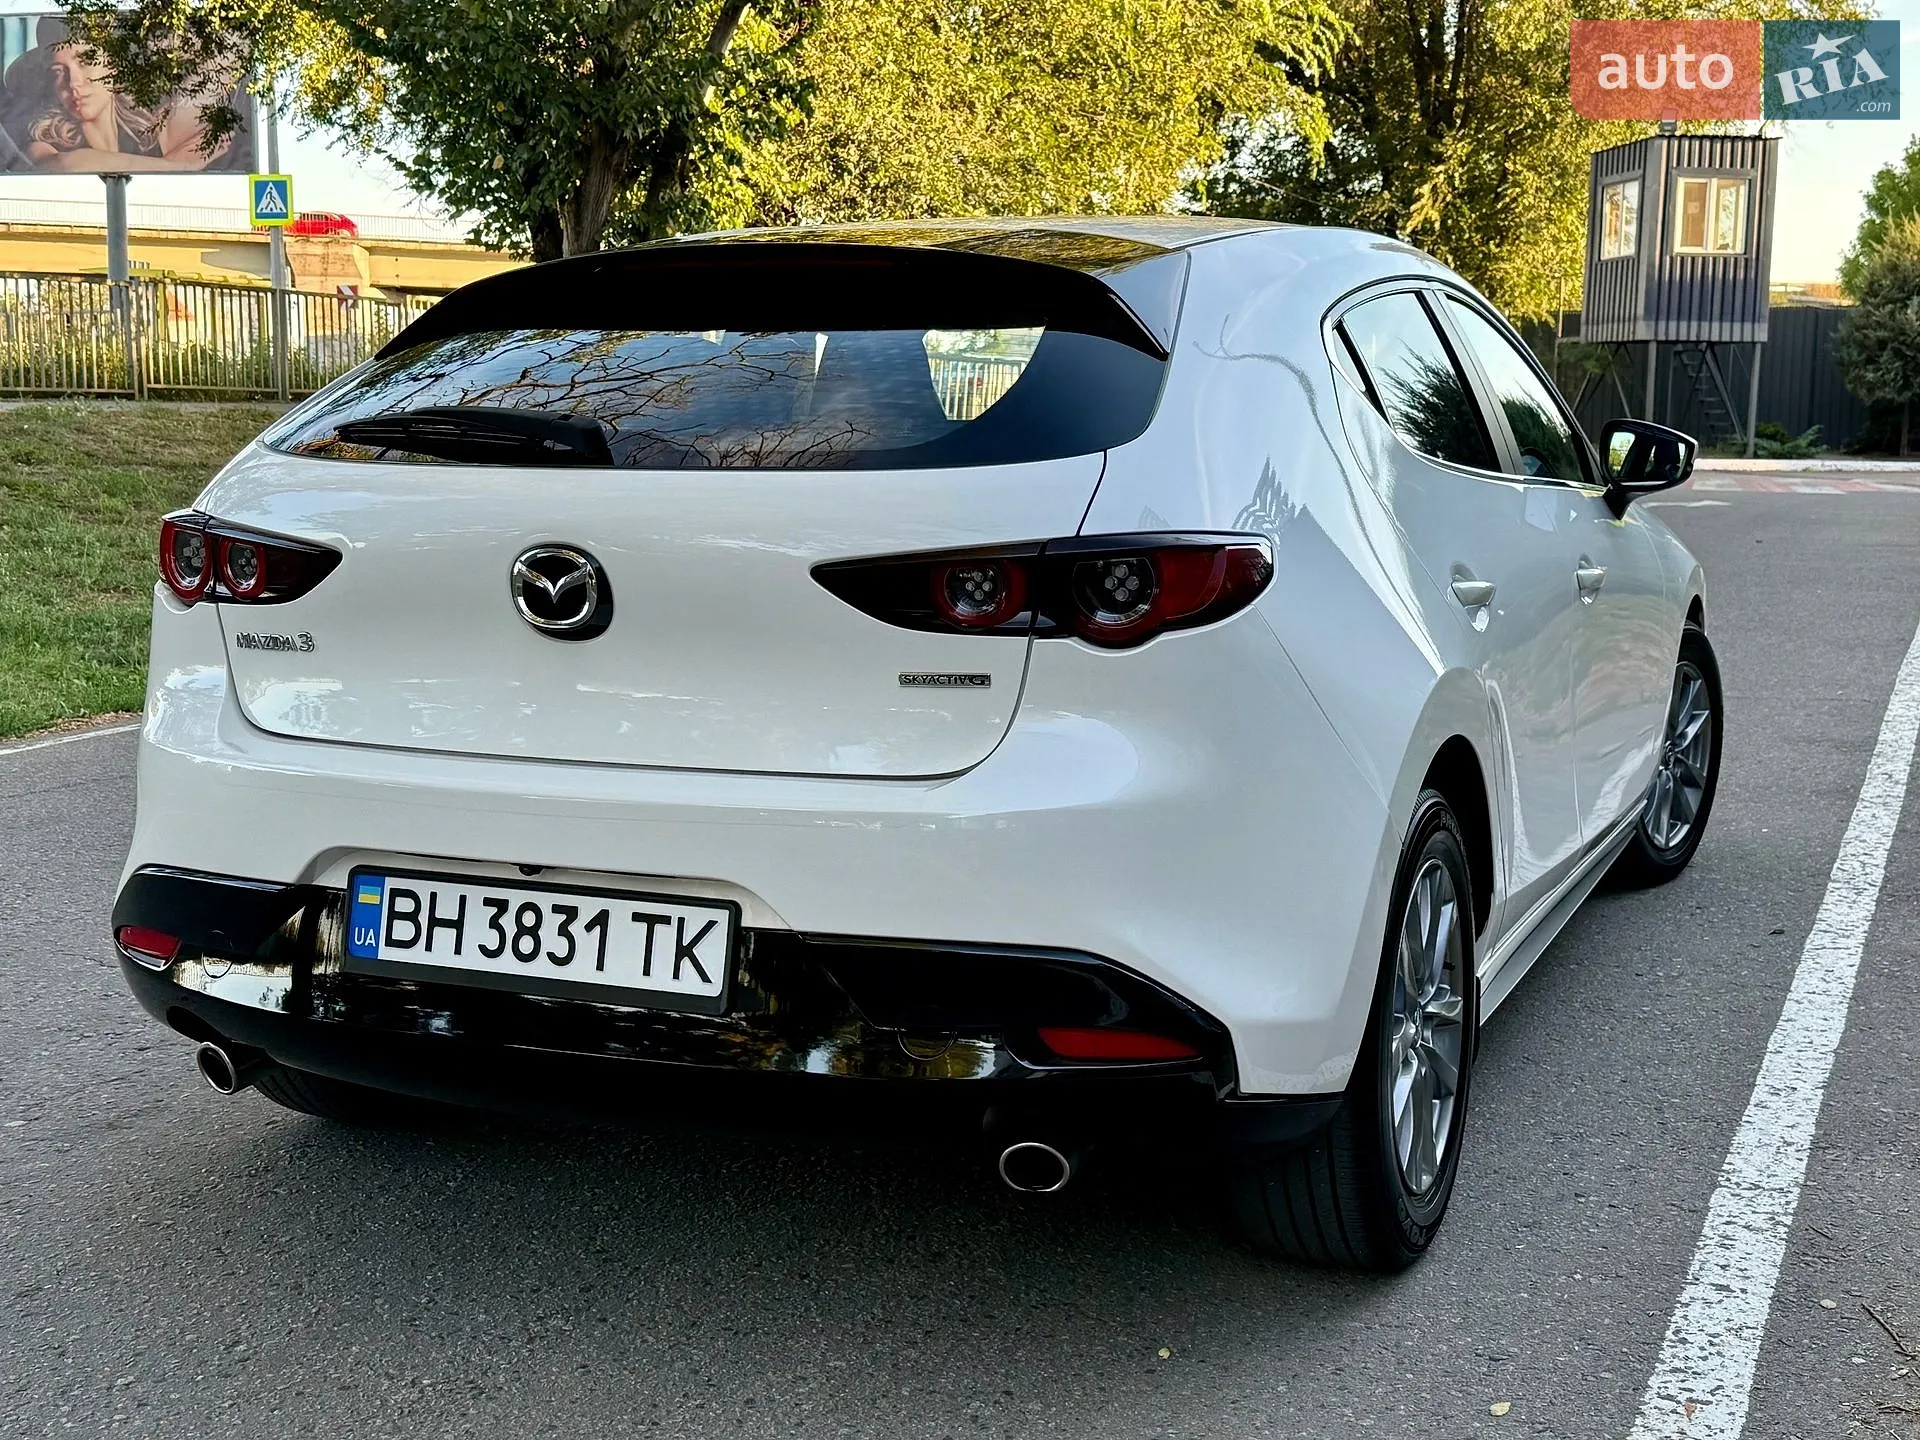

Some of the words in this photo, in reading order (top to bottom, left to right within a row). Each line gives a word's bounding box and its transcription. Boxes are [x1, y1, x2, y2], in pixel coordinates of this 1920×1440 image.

[354, 926, 377, 948] UA
[384, 886, 467, 955] BH
[477, 897, 610, 972] 3831
[631, 911, 719, 984] TK
